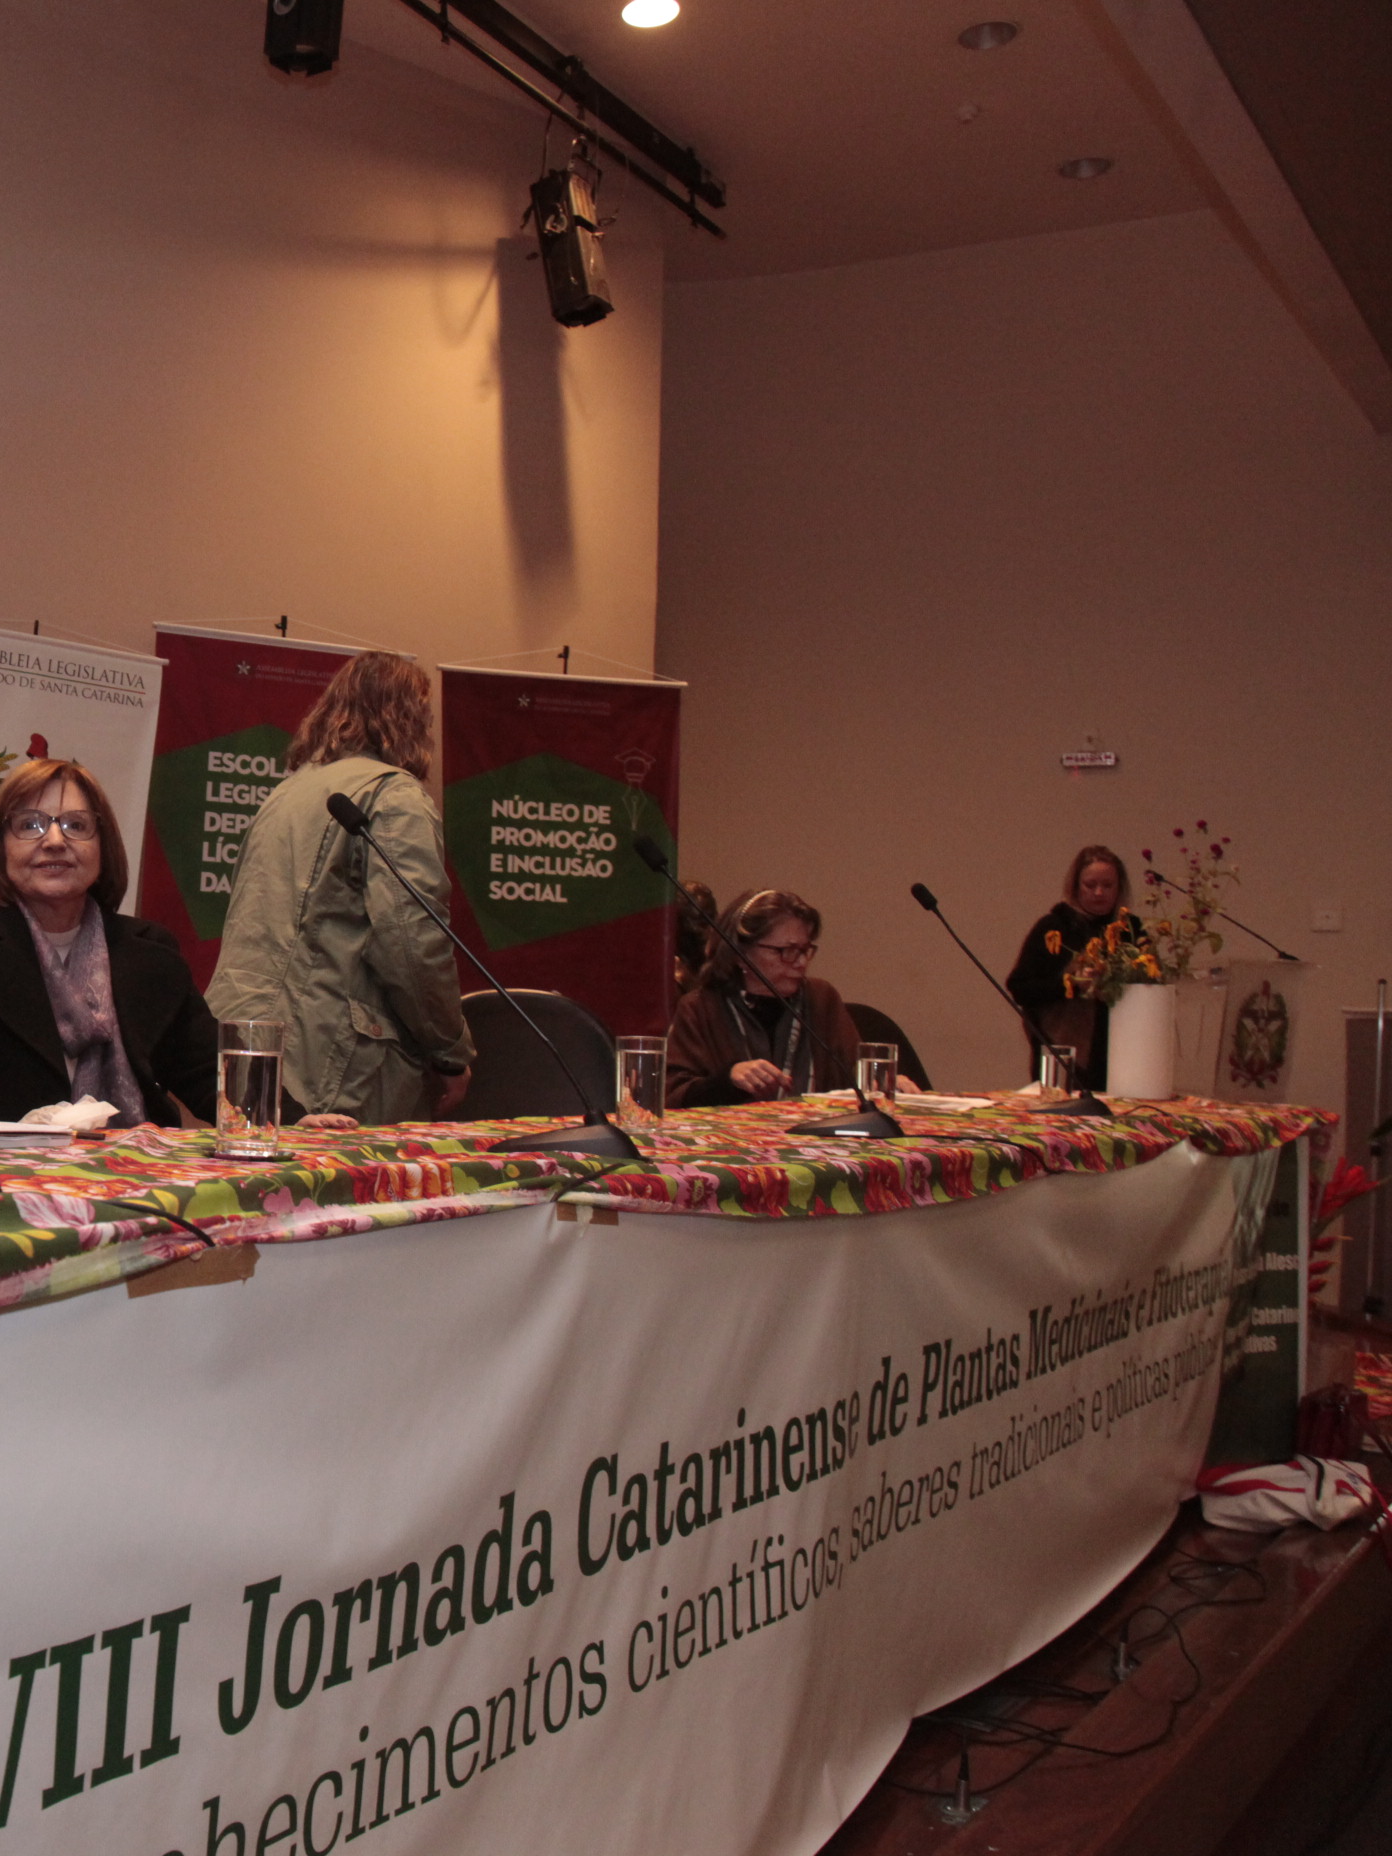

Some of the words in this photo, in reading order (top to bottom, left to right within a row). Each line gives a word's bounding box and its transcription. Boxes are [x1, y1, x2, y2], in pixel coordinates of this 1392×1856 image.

[47, 658, 145, 690] LEGISLATIVA
[19, 676, 36, 689] DE
[40, 680, 79, 697] SANTA
[81, 687, 144, 708] CATARINA
[206, 781, 275, 807] LEGIS
[204, 811, 256, 834] DEP
[491, 795, 580, 822] NÚCLEO
[583, 804, 611, 825] DE
[490, 826, 617, 855] PROMOÇÃO
[490, 853, 504, 872] E
[507, 853, 614, 878] INCLUSÃO
[488, 880, 568, 903] SOCIAL
[218, 1491, 554, 1735] Jornada
[578, 1390, 860, 1576] Catarinense
[867, 1355, 909, 1446] de
[917, 1327, 1020, 1427] Plantas
[1025, 1280, 1134, 1381] Medicinais
[1135, 1288, 1147, 1333] e
[628, 1525, 844, 1693] científicos,
[850, 1460, 961, 1564] saberes
[969, 1386, 1085, 1500] tradicionais
[1091, 1389, 1102, 1432] e
[1106, 1354, 1170, 1438] políticas
